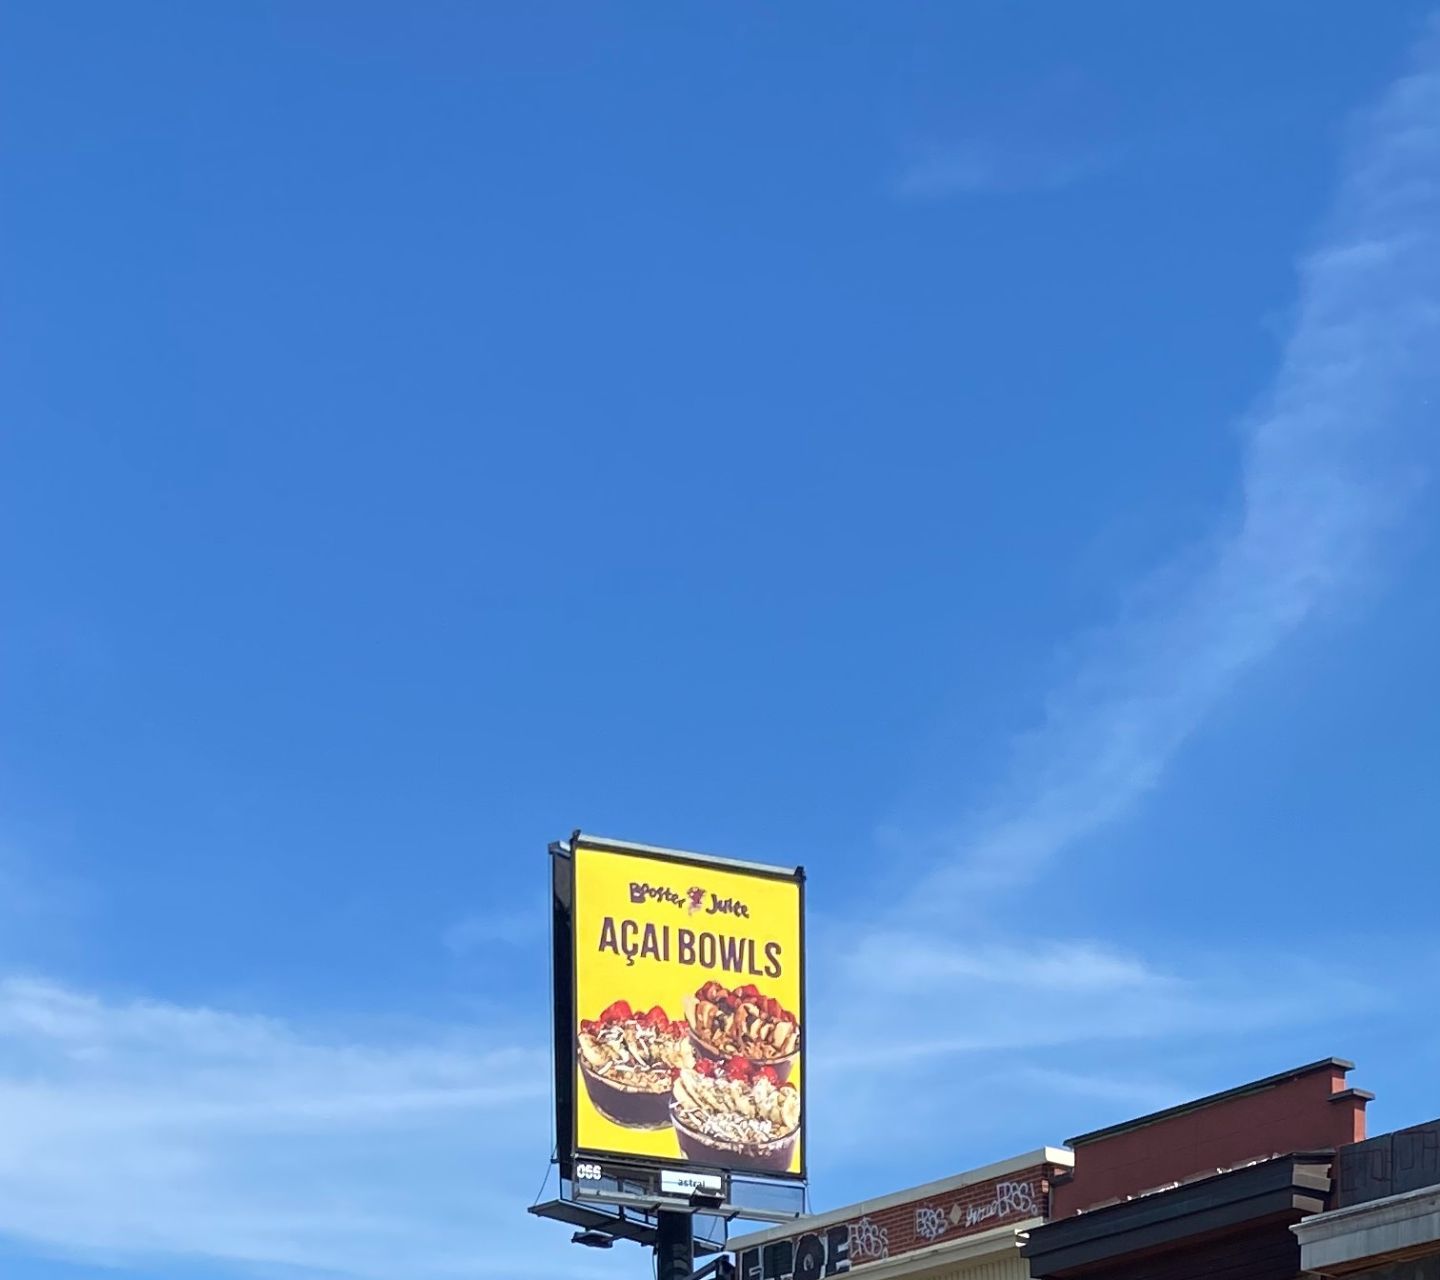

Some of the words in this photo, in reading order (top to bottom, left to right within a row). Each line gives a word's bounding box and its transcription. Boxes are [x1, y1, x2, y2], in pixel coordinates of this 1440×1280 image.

[629, 882, 684, 908] Booster
[706, 894, 750, 919] Juice
[598, 917, 670, 967] AÇAI
[678, 928, 782, 979] BOWLS
